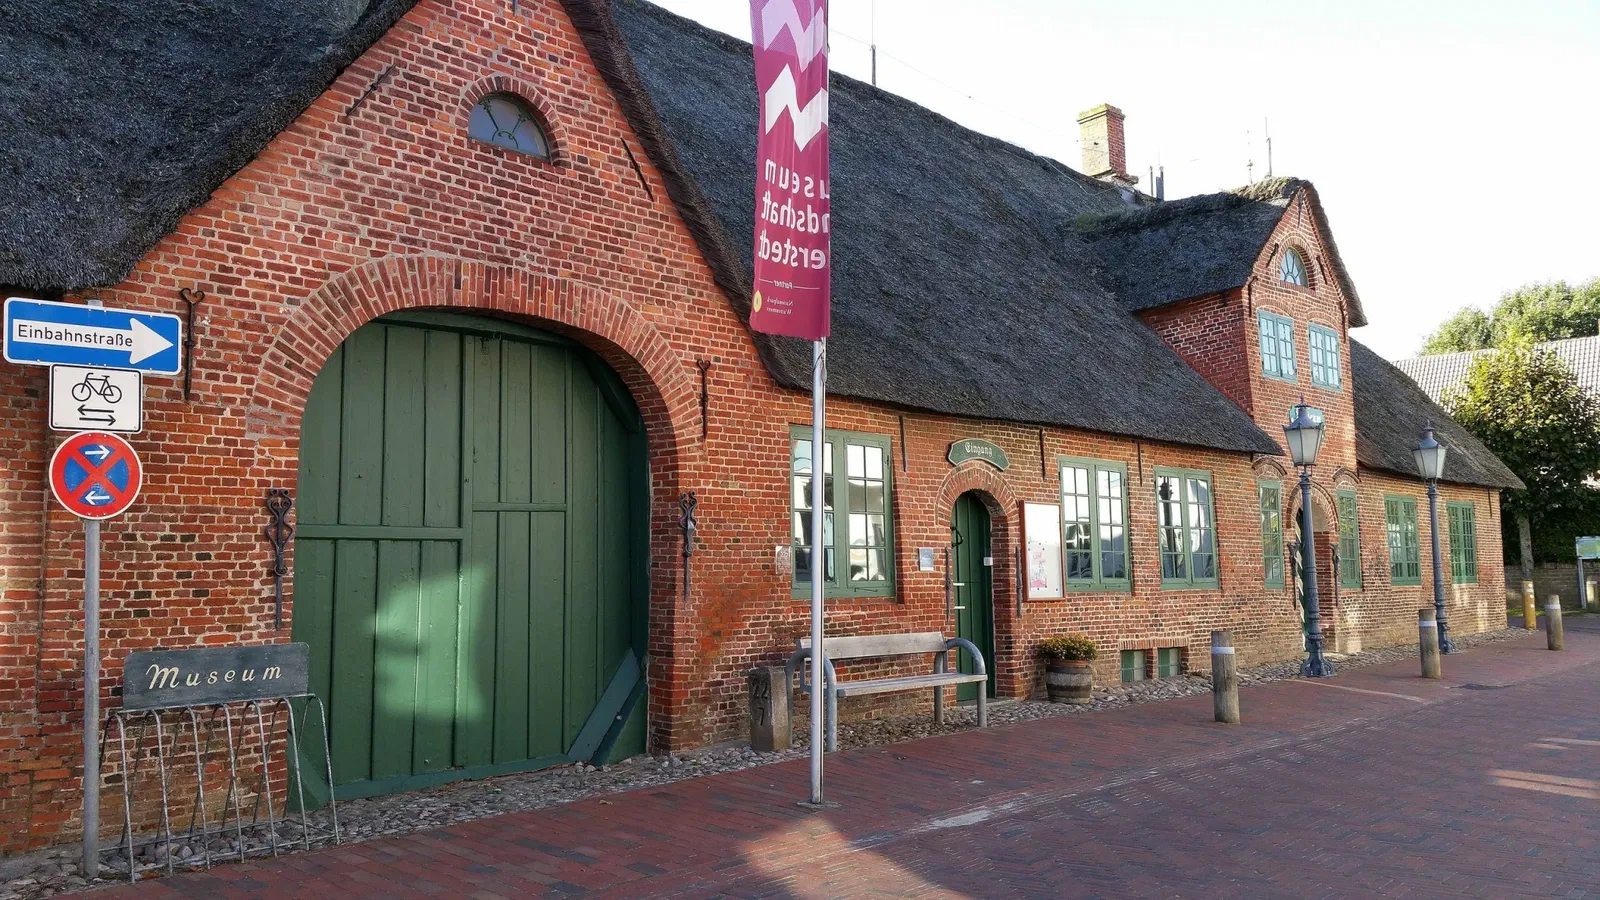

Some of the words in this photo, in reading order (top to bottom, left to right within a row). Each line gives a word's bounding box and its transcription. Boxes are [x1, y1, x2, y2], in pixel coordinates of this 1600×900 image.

[18, 324, 132, 347] Einbahnstraße
[965, 441, 992, 457] Eingang
[145, 663, 282, 690] Museum
